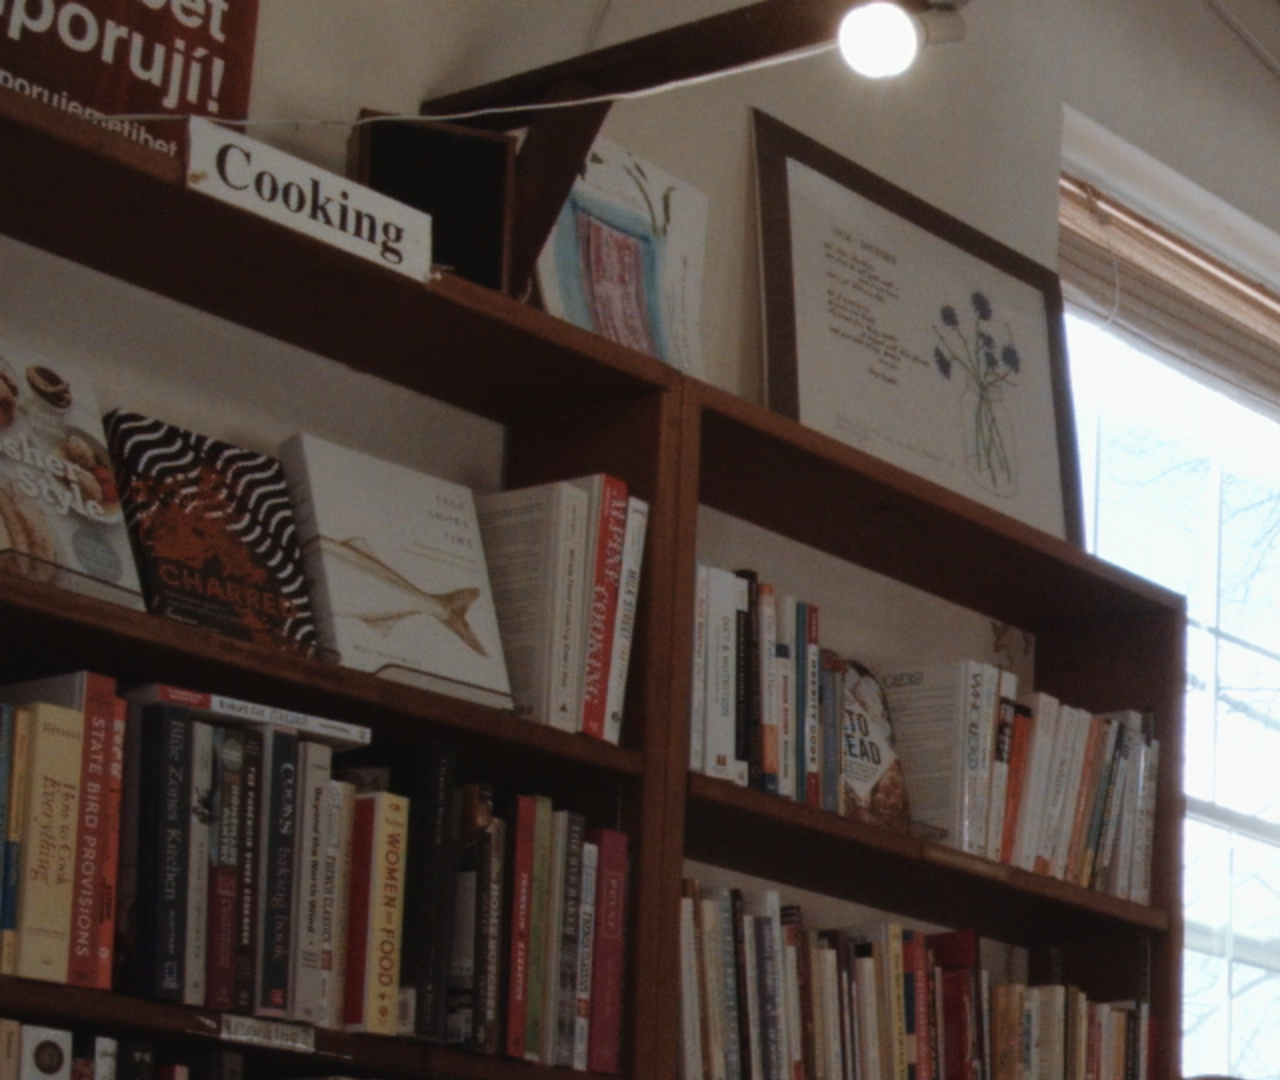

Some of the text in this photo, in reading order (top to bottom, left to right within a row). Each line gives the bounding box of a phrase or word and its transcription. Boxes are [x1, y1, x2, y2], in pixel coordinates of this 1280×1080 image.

[0, 0, 226, 115] porují!
[215, 143, 405, 266] Cooking
[2, 432, 84, 482] sher
[18, 467, 105, 523] Style
[603, 493, 627, 587] ALPINE
[584, 585, 611, 704] COOKING
[719, 655, 731, 717] NUTRITION
[844, 709, 869, 737] TO
[844, 733, 882, 766] EAD
[31, 774, 63, 886] Everything
[56, 783, 76, 887] How to Cook
[76, 716, 106, 958] STATE BIRD PROVISIONS
[164, 719, 185, 901] Blue Zones Kitchen
[219, 807, 231, 865] PANTRY
[228, 784, 240, 865] HOMEMADE
[273, 846, 291, 960] baking book
[307, 786, 324, 934] Beyond the North Wind
[384, 833, 403, 909] WOMEN
[377, 927, 396, 988] FOOD
[486, 884, 500, 1023] HOME BUTCHER
